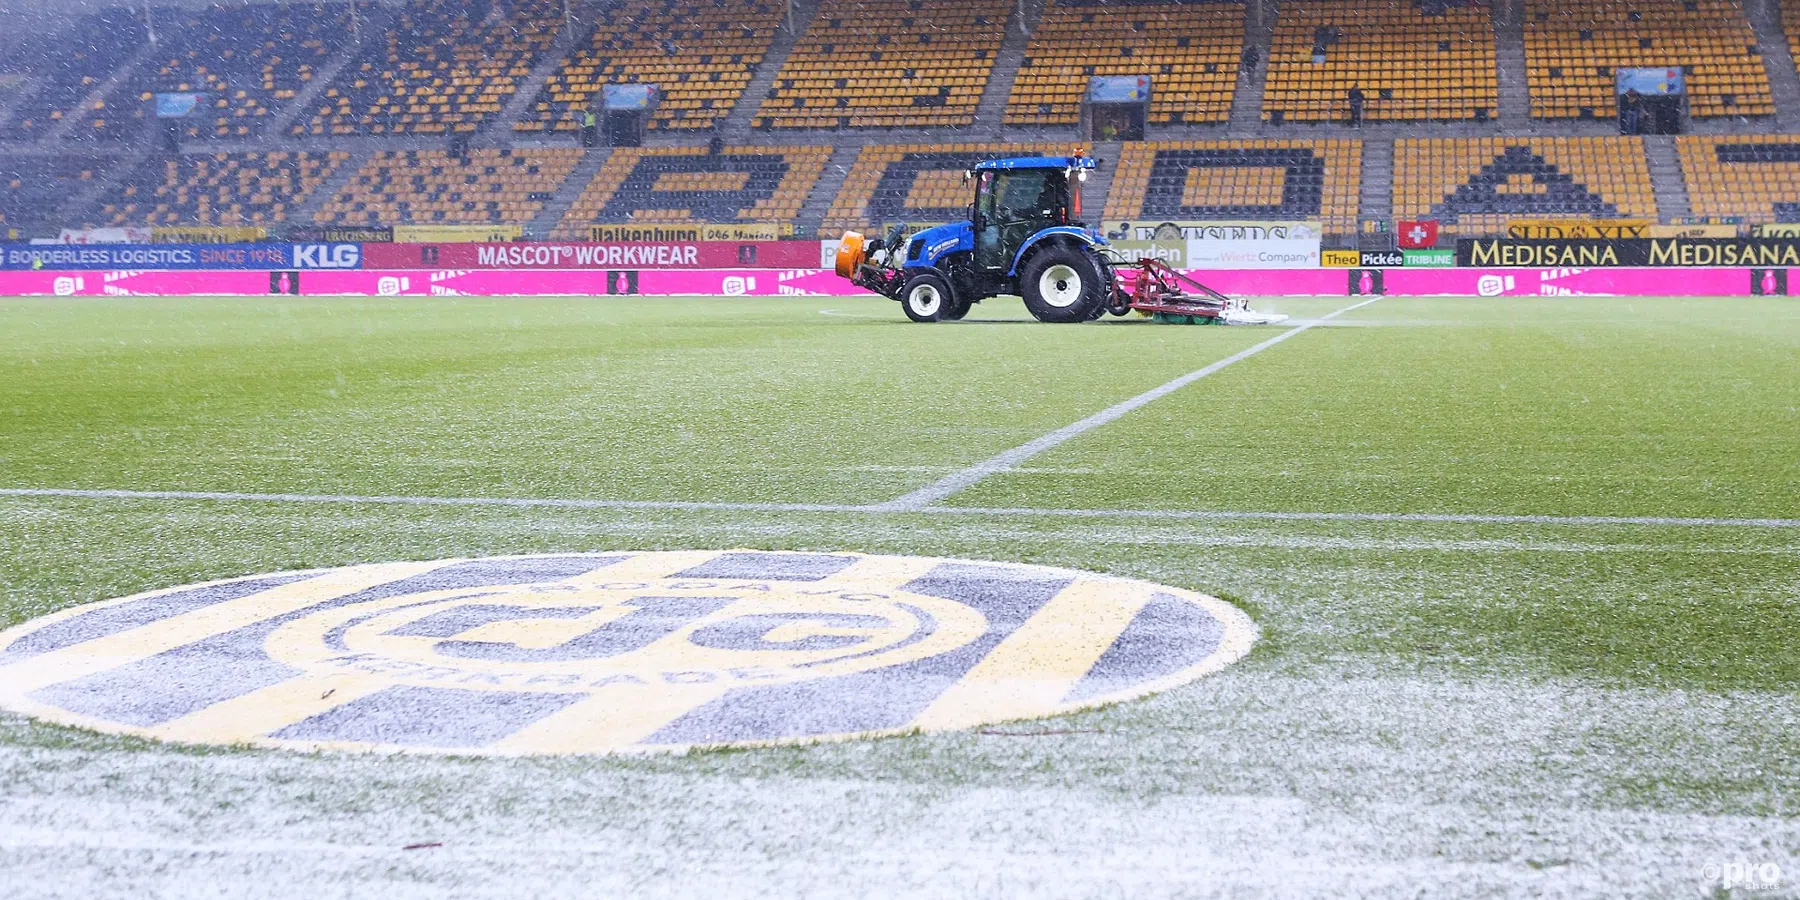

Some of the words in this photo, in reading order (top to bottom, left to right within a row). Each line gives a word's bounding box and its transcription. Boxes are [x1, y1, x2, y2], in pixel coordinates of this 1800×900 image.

[9, 250, 109, 264] BORDERLESS
[113, 249, 196, 264] LOGISTICS.
[201, 250, 244, 263] SINCE
[293, 244, 360, 268] KLG
[576, 245, 698, 265] WORKWEAR
[1258, 251, 1309, 263] Company
[1326, 254, 1358, 266] Theo
[1362, 252, 1403, 266] Pickée
[1406, 254, 1452, 265] TRIBUNE
